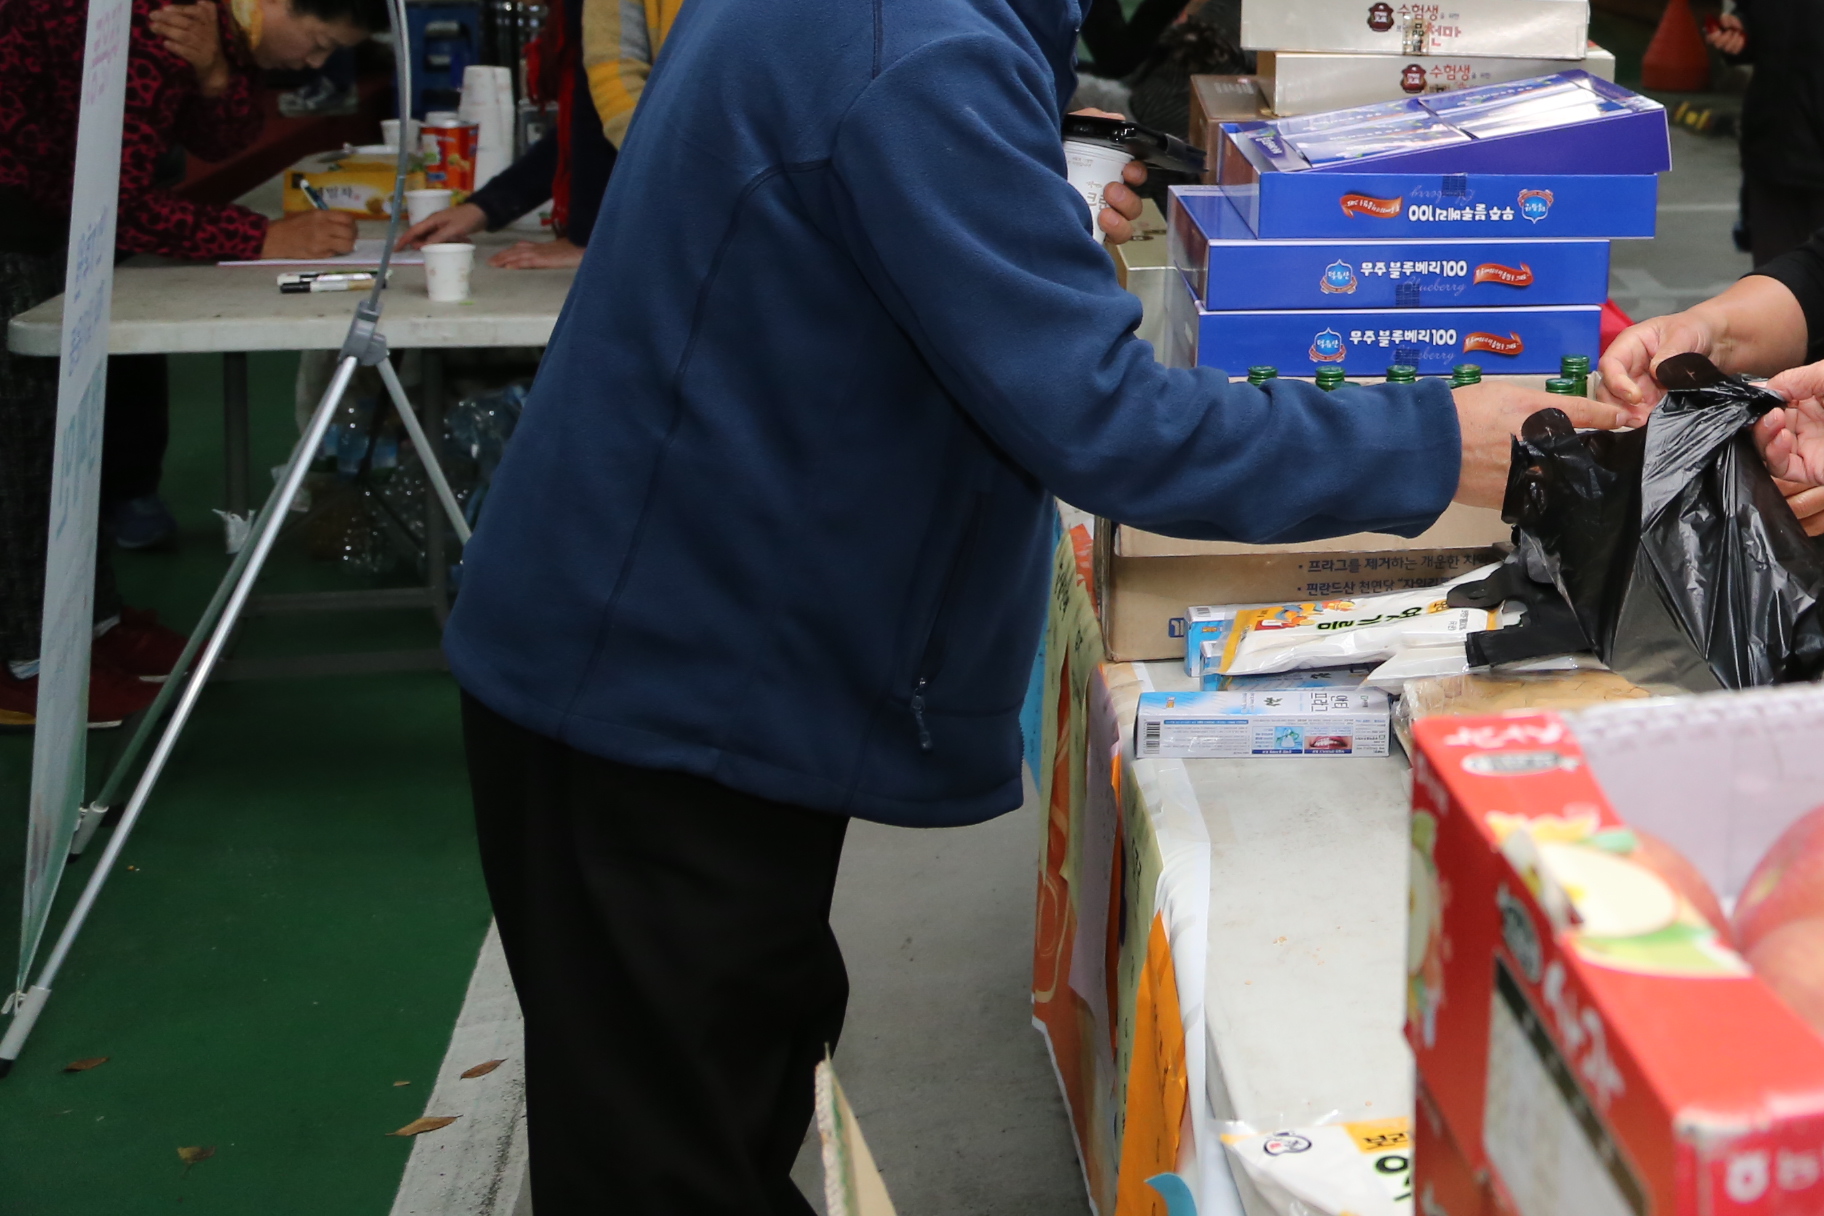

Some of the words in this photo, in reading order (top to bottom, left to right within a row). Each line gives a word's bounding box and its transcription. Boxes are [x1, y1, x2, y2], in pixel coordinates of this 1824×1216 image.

[1424, 21, 1463, 47] 천마
[1489, 205, 1516, 222] 무주
[1360, 261, 1388, 277] 무주
[1388, 260, 1468, 280] 블루베리100
[1349, 329, 1377, 345] 무주
[1377, 329, 1457, 348] 블루베리100
[1307, 559, 1361, 573] 프라그를
[1364, 556, 1418, 571] 제거하는
[1420, 554, 1460, 570] 개운한
[1306, 582, 1356, 597] 핀란드산
[1316, 606, 1423, 631] 엿기름
